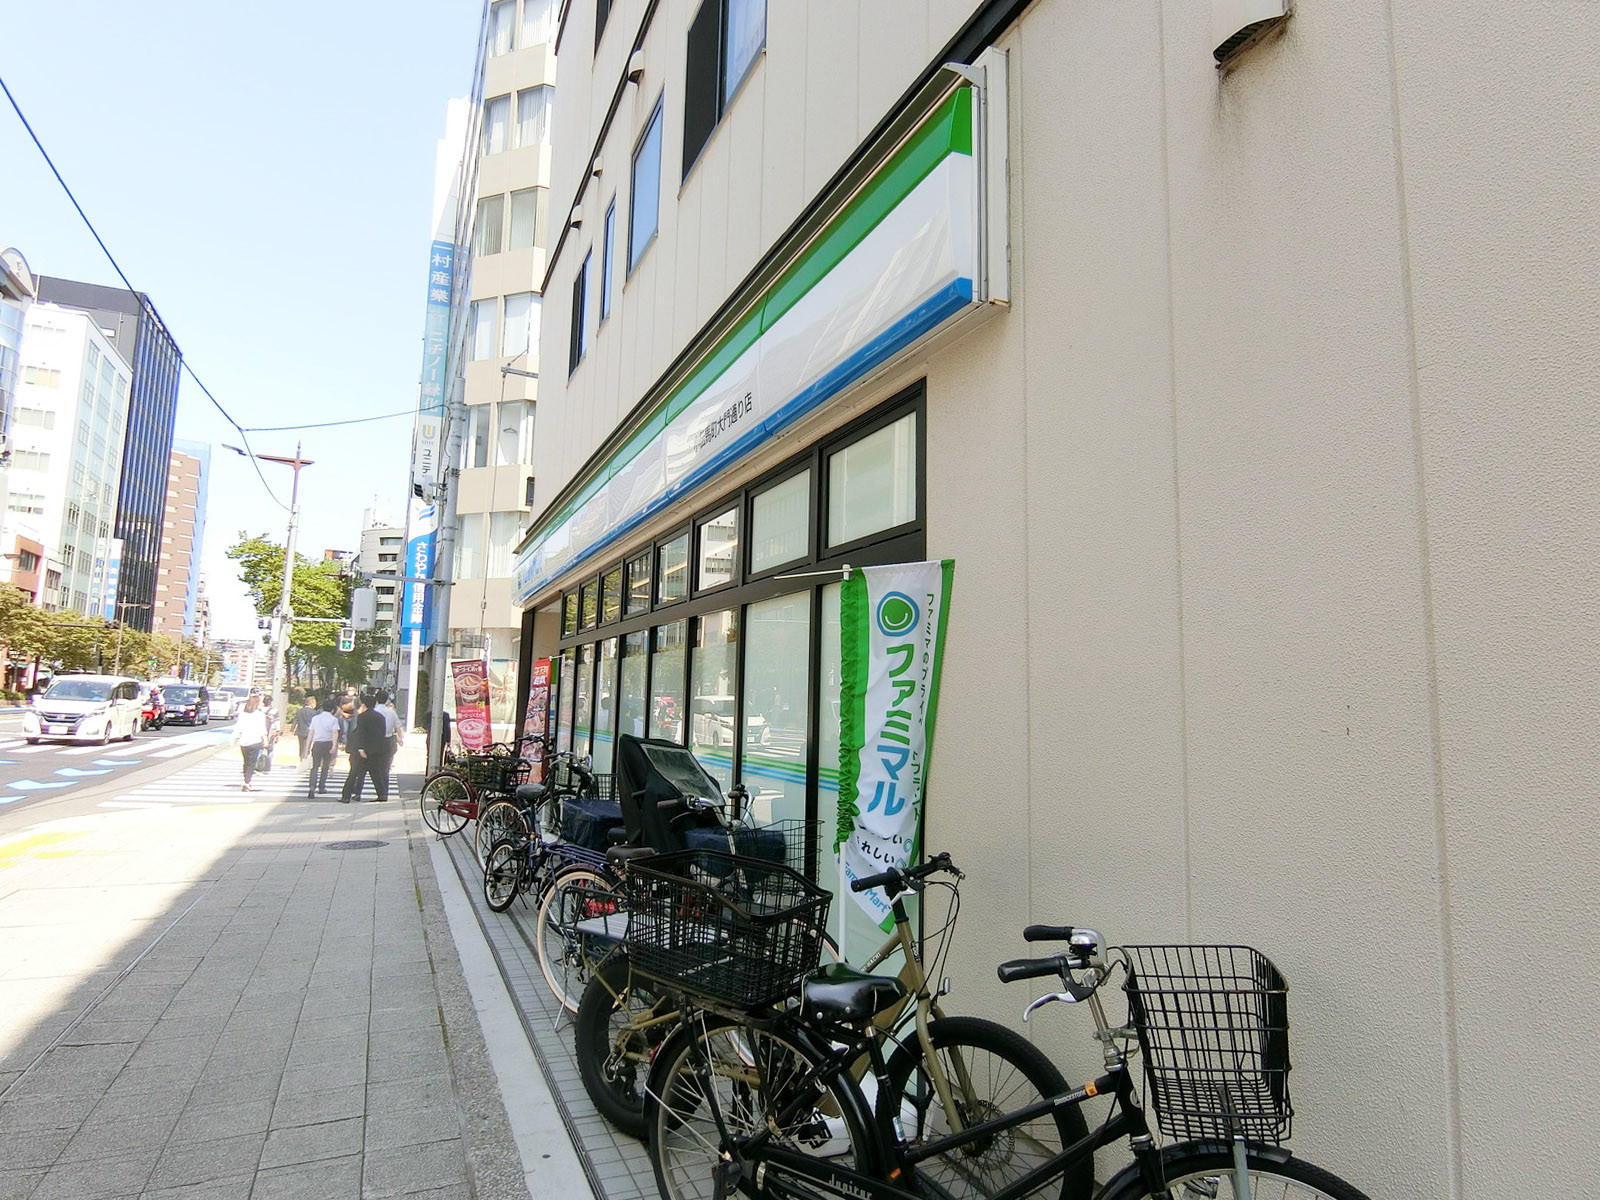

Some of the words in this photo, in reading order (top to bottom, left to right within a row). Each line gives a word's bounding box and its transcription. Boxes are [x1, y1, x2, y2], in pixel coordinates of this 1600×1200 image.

[866, 643, 916, 817] ファミマル
[856, 836, 896, 864] れしい
